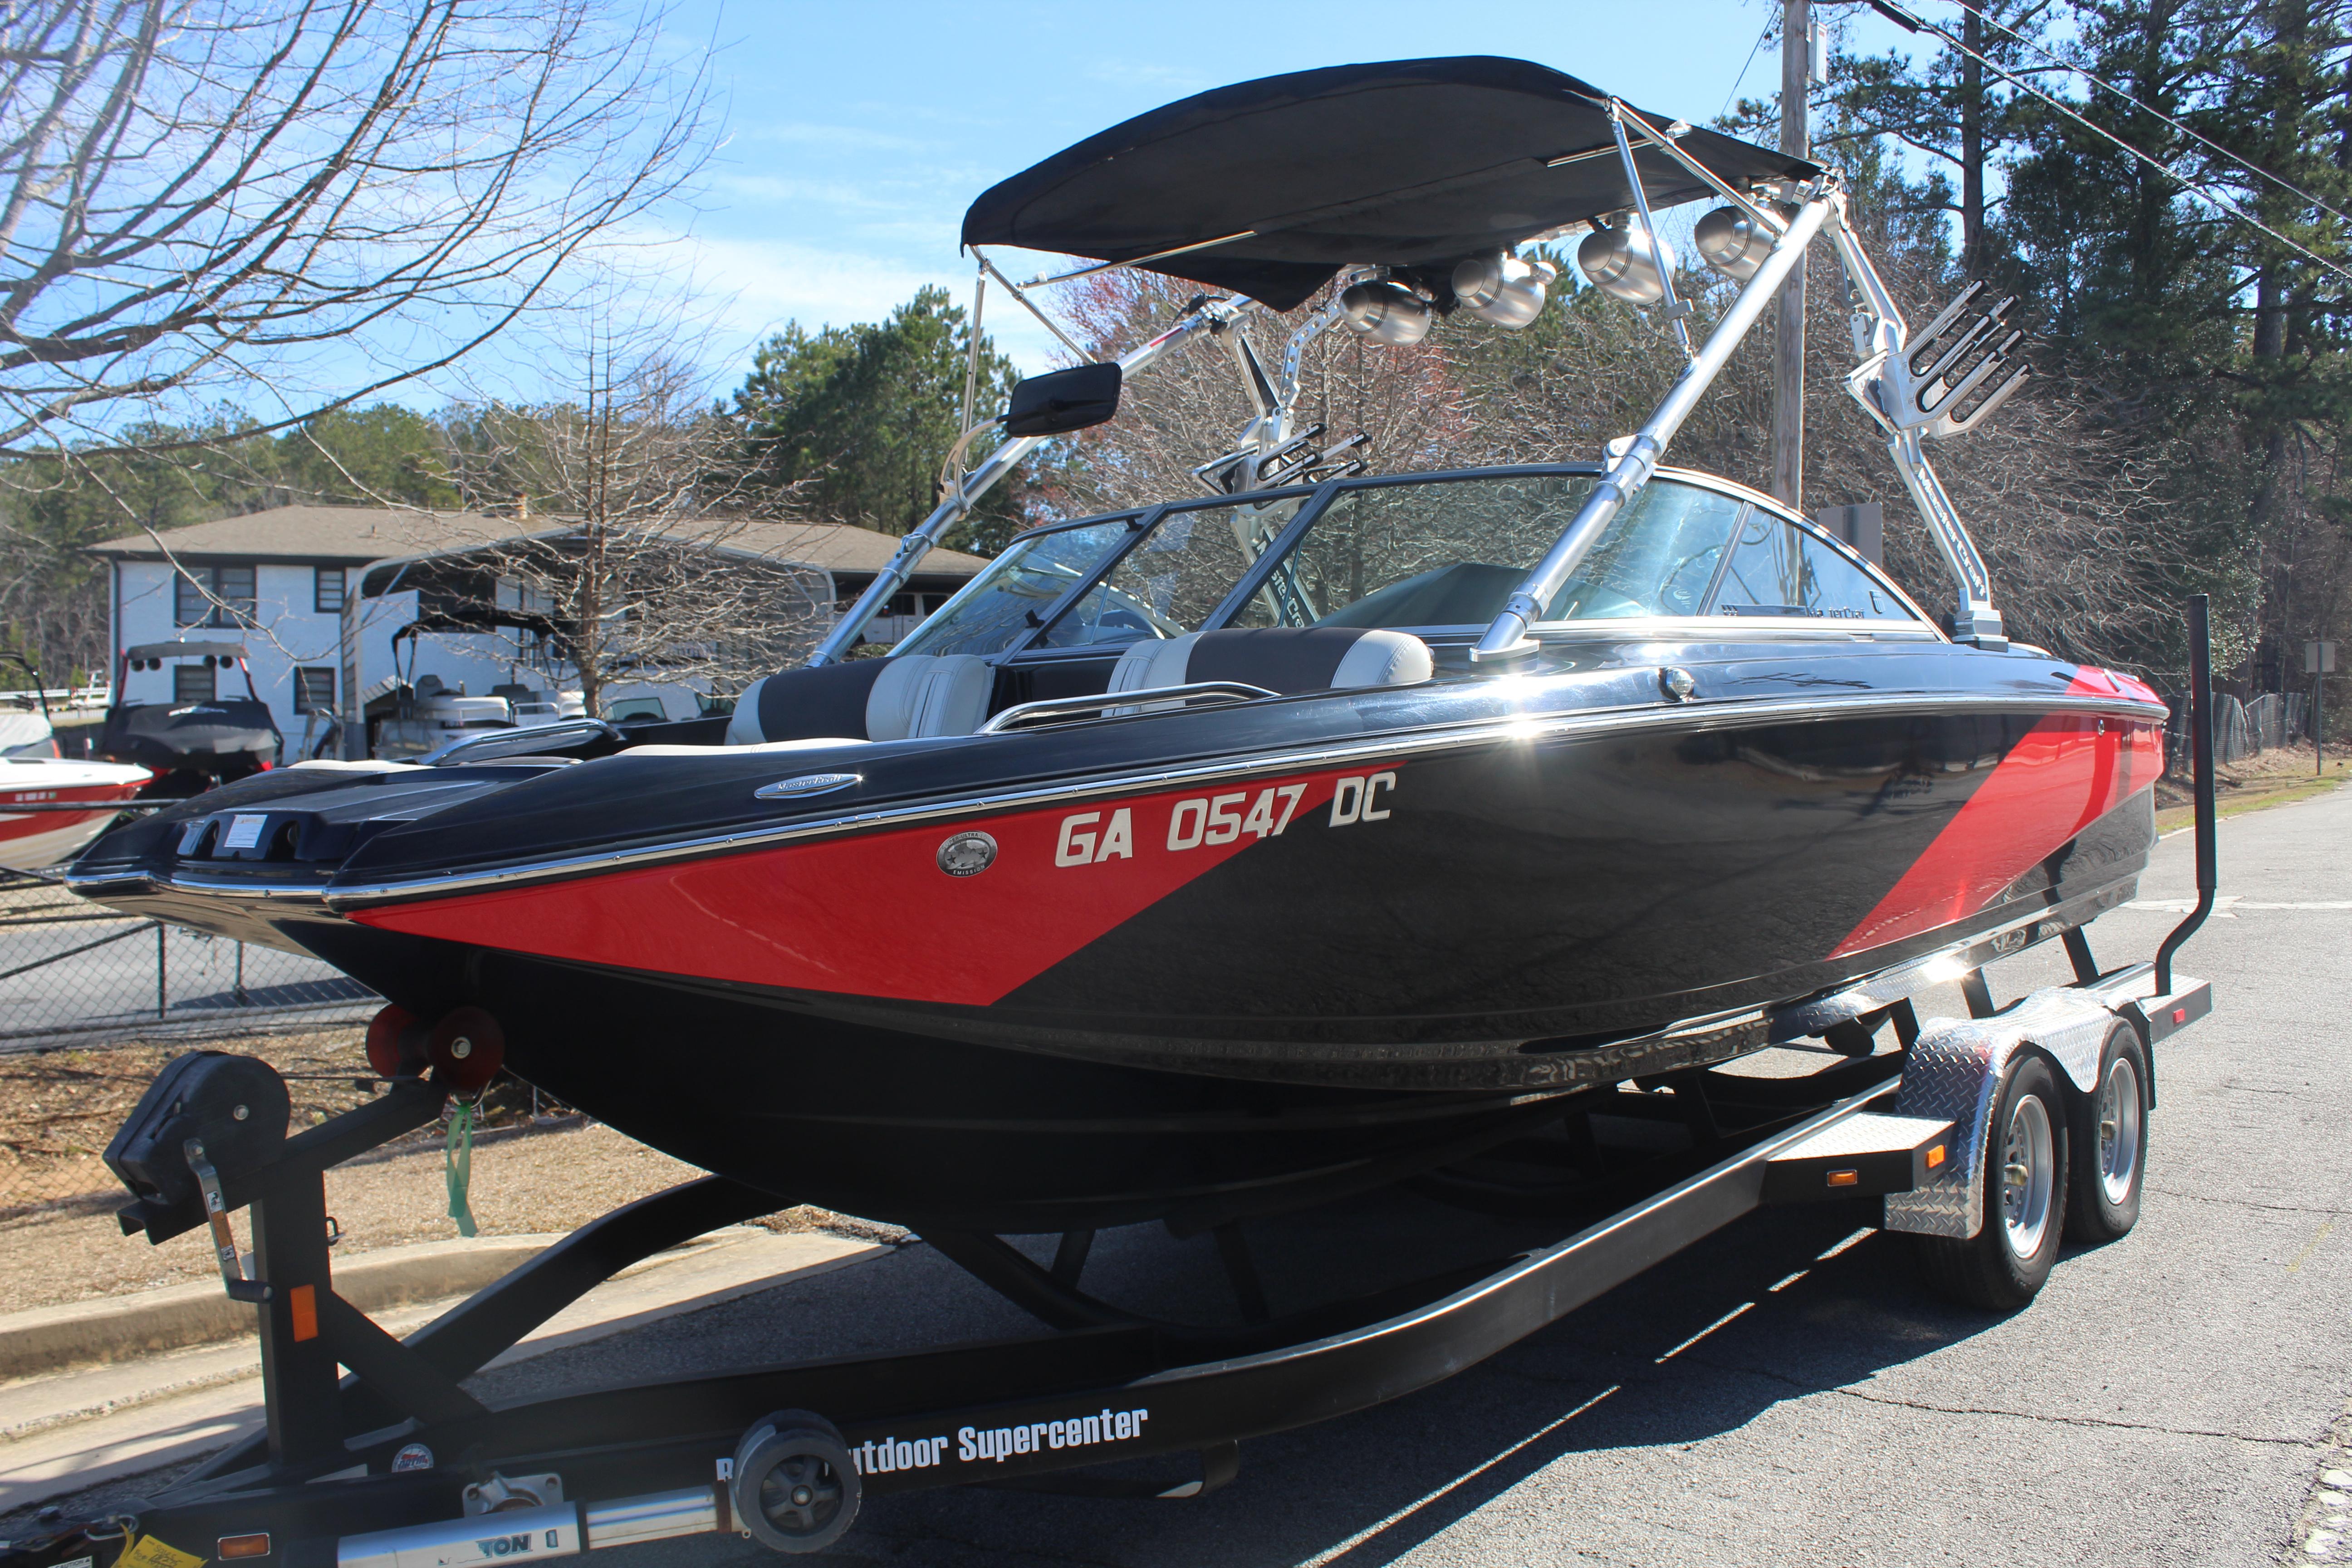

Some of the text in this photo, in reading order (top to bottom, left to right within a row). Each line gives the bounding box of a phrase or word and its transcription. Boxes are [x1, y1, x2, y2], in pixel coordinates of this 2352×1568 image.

[1918, 467, 1986, 597] MasterCraft
[777, 774, 843, 791] MasterCraft
[1055, 771, 1396, 868] GA 0547 DC
[953, 864, 985, 875] EMISSION
[848, 1409, 1148, 1475] utdoor Supercenter
